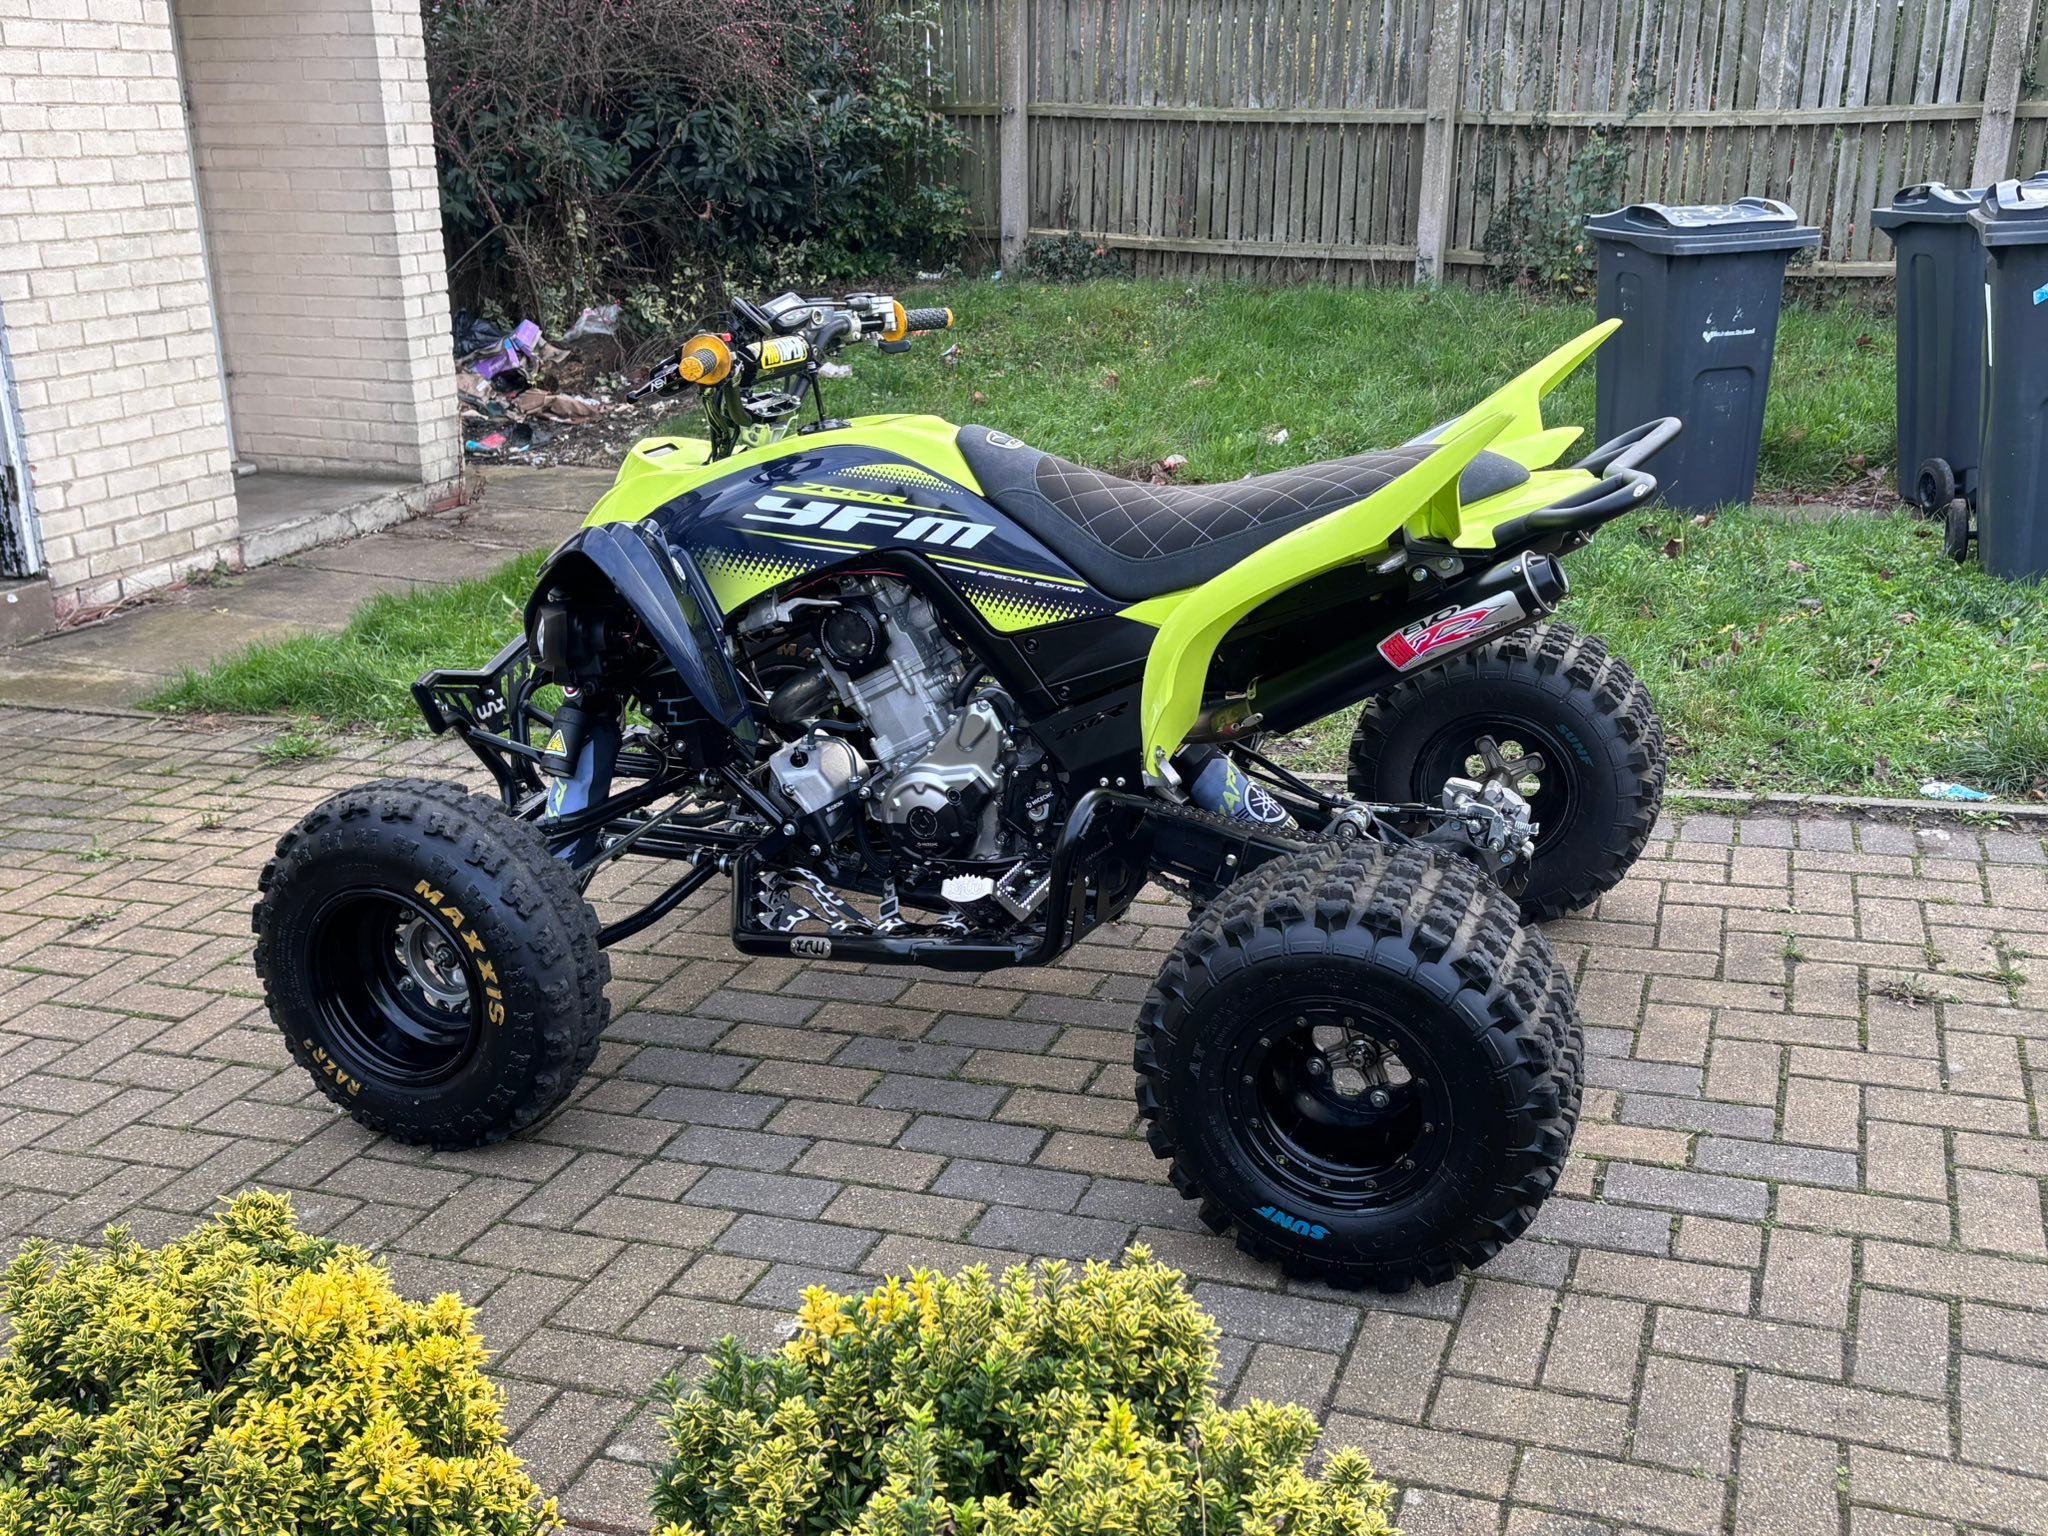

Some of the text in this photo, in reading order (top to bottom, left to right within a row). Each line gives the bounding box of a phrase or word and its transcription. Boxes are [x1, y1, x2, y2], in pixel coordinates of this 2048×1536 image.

[650, 376, 667, 392] ASV
[742, 495, 997, 549] YFM
[978, 571, 1085, 594] SPECIAL EDITION
[1555, 723, 1595, 768] SUNF
[414, 879, 505, 1026] MAXXIS
[312, 1046, 361, 1096] RAZR
[1252, 1206, 1332, 1240] SUNF
